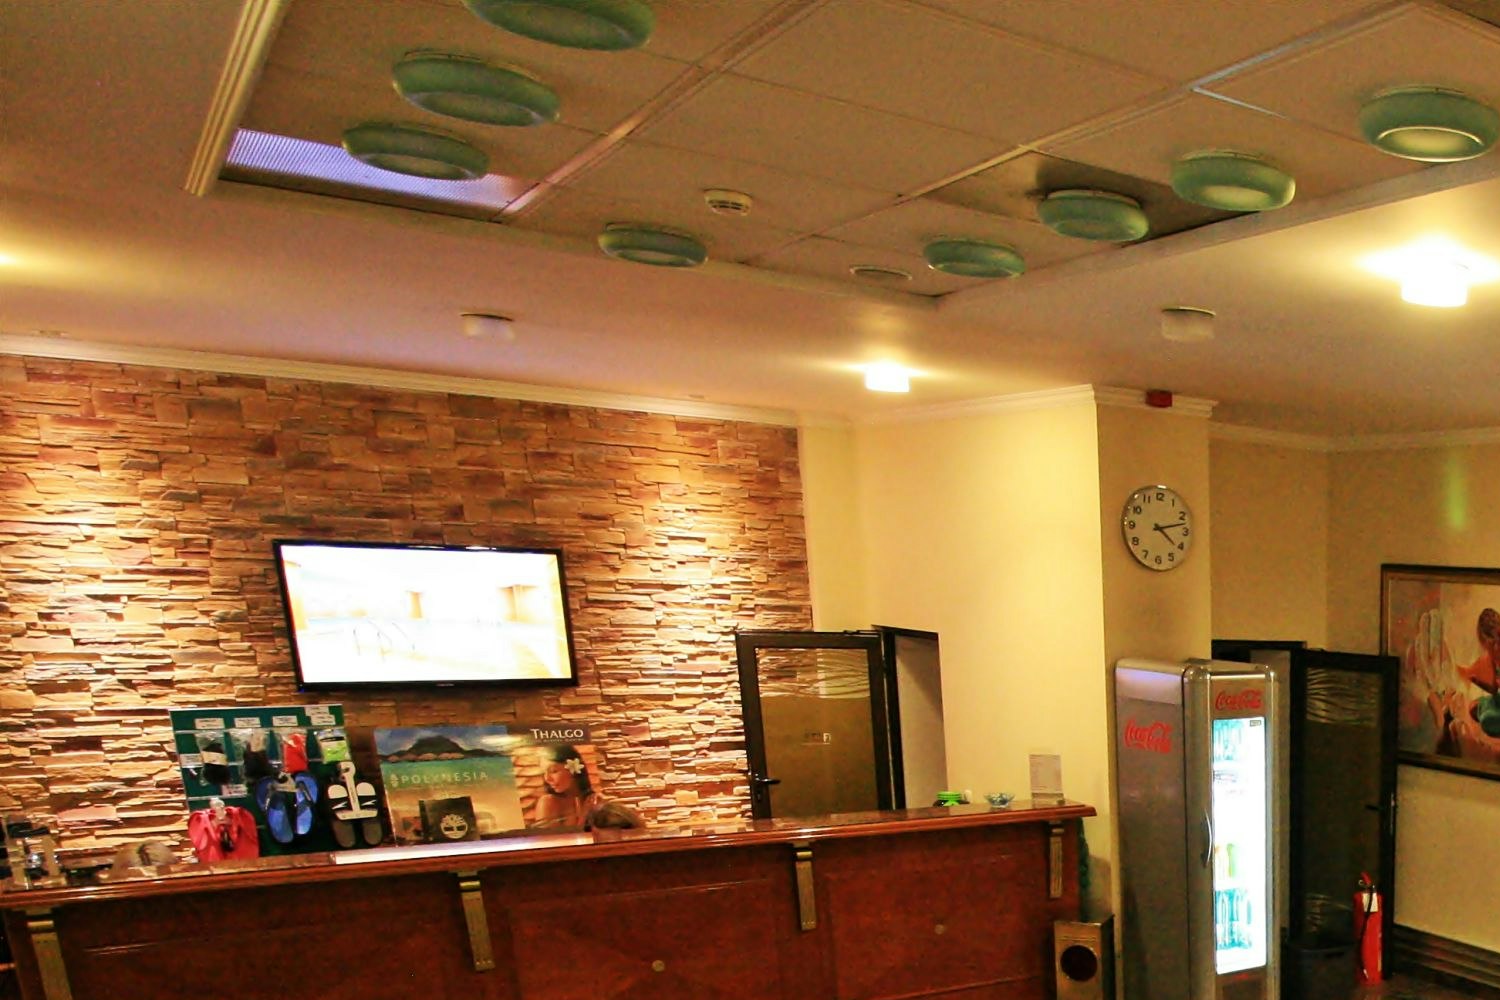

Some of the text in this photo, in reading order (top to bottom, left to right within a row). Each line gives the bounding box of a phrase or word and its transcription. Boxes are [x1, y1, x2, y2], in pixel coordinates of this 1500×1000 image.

[1143, 494, 1151, 504] 11
[1156, 492, 1165, 502] 12
[1133, 505, 1142, 515] 10
[1179, 511, 1186, 521] 2
[1128, 520, 1136, 530] 9
[1183, 527, 1189, 536] 3
[1132, 537, 1139, 546] 8
[1178, 542, 1184, 550] 4
[1142, 549, 1149, 559] 7
[1168, 552, 1175, 562] 5
[1155, 555, 1162, 565] 6
[401, 771, 489, 784] POLYNESIA
